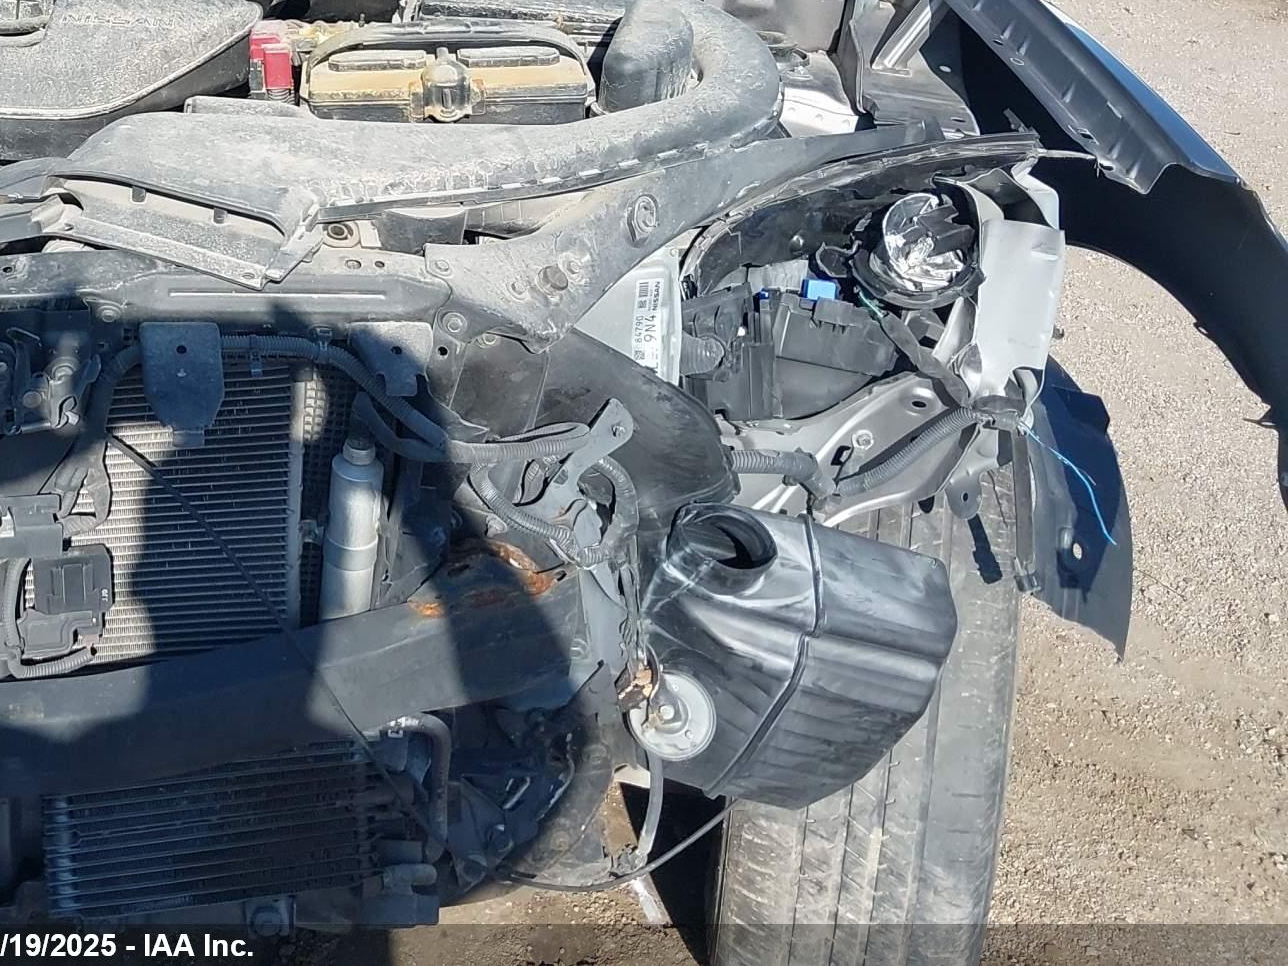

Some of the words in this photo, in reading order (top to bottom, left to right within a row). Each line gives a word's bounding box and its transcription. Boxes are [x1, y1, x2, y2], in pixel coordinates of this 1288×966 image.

[59, 12, 177, 27] NISSAN
[652, 281, 661, 311] NISSAN
[643, 315, 657, 343] 9N4
